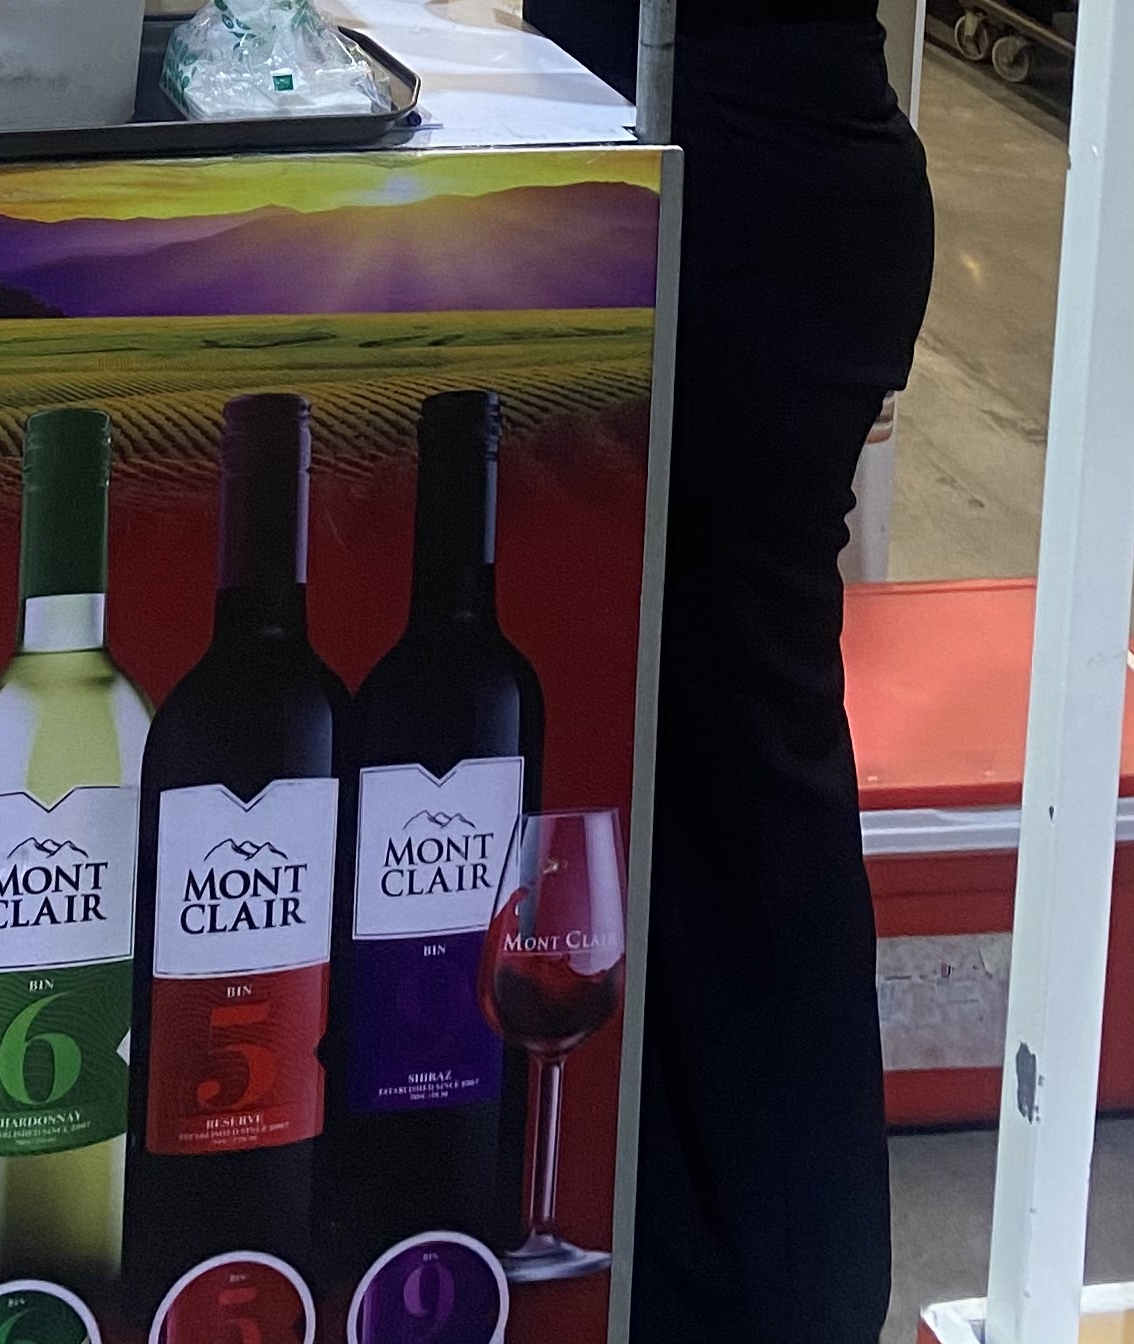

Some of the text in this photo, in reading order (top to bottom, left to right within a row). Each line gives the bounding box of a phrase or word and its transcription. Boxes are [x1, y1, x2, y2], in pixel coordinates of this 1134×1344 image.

[383, 832, 494, 868] MONT
[183, 863, 308, 902] MONT
[381, 862, 494, 898] CLAIR
[180, 897, 306, 935] CLAIR
[423, 944, 447, 957] BIN
[28, 978, 54, 992] BIN
[226, 985, 253, 998] BIN
[196, 1001, 278, 1111] 5
[407, 1069, 452, 1084] SHIRAZ
[206, 1113, 264, 1130] RESERVE
[403, 1262, 456, 1343] 9
